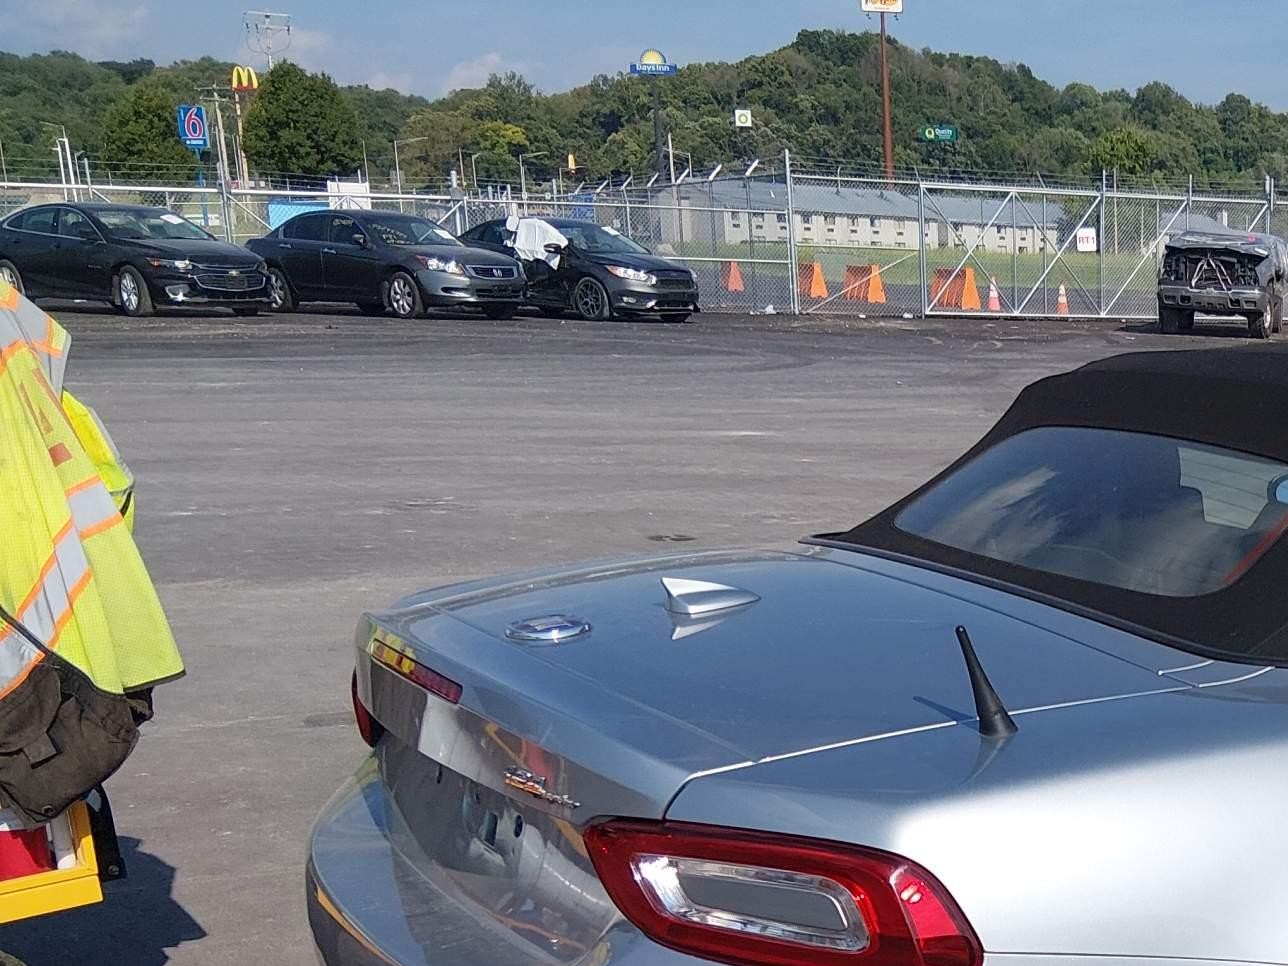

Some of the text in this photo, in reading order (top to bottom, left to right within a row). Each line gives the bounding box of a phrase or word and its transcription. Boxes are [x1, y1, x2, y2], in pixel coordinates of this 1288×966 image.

[636, 63, 655, 73] Days
[656, 63, 670, 72] Inn
[185, 107, 204, 139] 6
